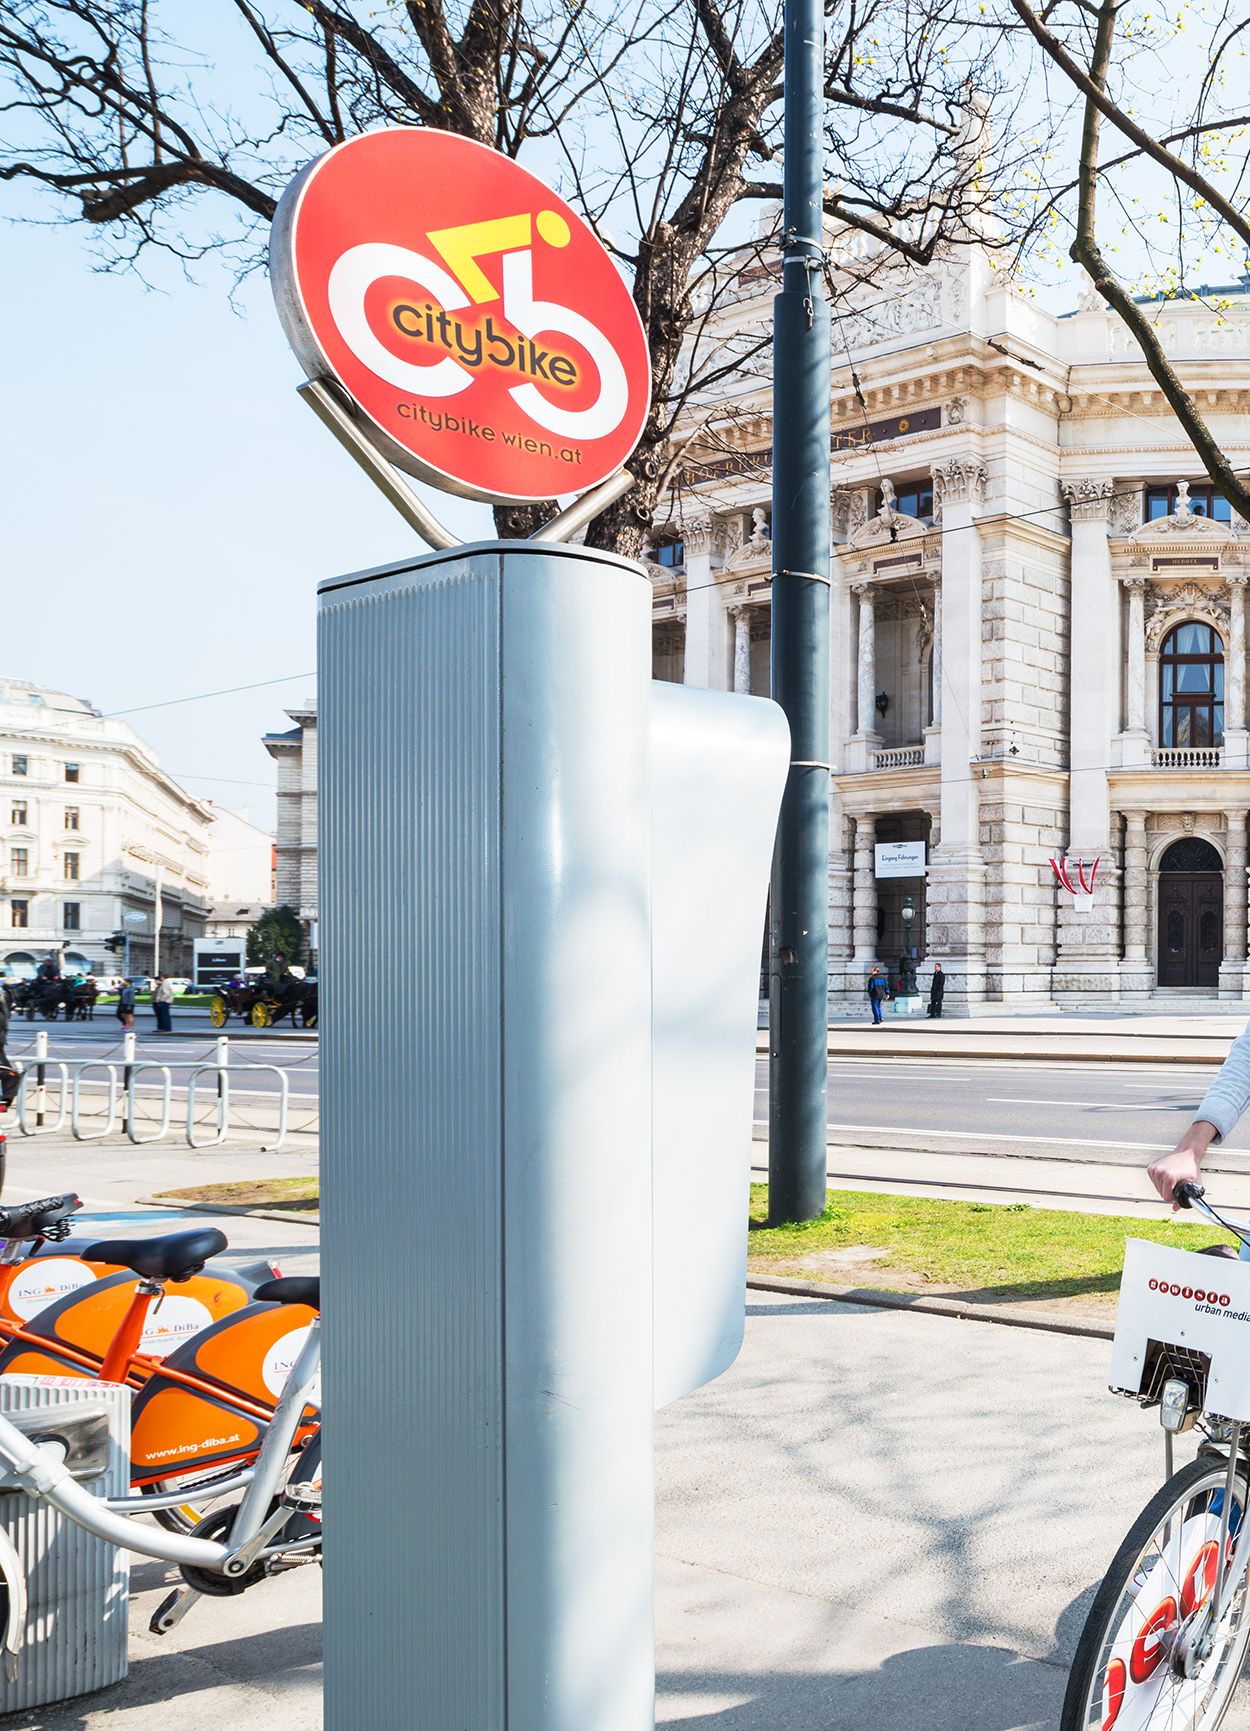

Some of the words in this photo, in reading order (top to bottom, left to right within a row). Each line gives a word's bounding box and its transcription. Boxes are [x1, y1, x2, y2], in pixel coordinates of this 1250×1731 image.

[392, 303, 577, 386] citybike
[18, 1287, 42, 1298] ING
[1194, 1302, 1222, 1317] urban
[174, 1322, 200, 1333] DiBa
[145, 1433, 240, 1461] www.ing-diba.at
